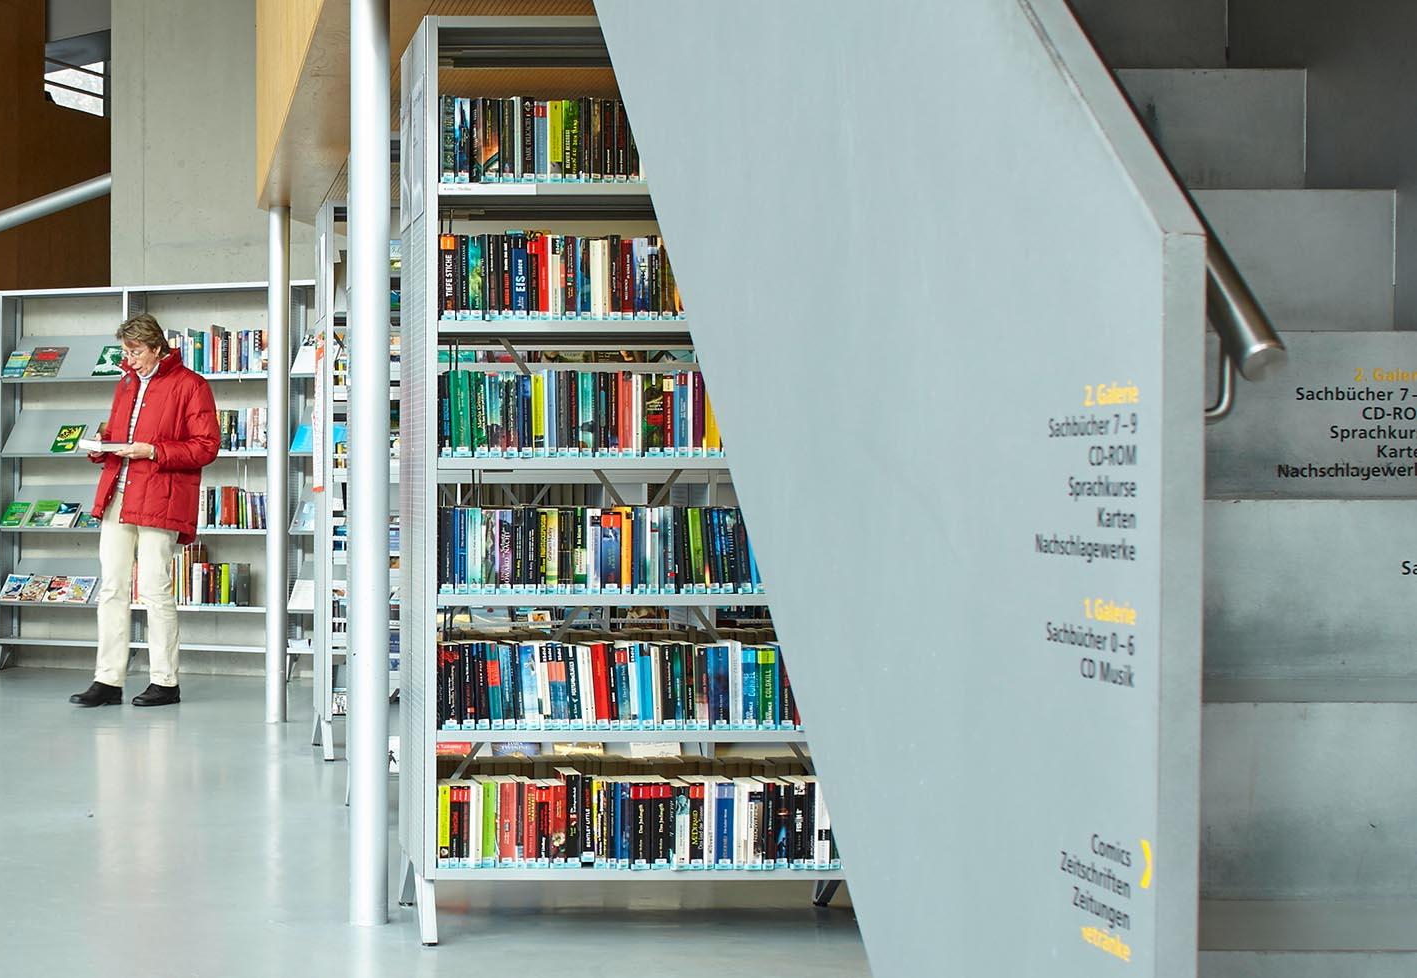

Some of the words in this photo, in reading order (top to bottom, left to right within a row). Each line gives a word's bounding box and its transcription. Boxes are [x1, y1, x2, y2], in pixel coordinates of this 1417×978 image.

[444, 254, 454, 278] STICHE
[444, 278, 454, 297] TIEFE
[1096, 380, 1140, 406] Galerie
[1295, 386, 1394, 401] Sachbücher
[1362, 406, 1417, 420] CD-RO
[1048, 416, 1110, 439] Sachbücher
[1330, 425, 1417, 442] Sprachkur
[1088, 444, 1137, 467] CD-ROM
[1067, 475, 1137, 502] Sprachkurse
[1097, 507, 1136, 530] Karten
[1034, 533, 1136, 563] Nachschlagewerke
[1095, 600, 1137, 626] Galerie
[1046, 621, 1108, 653] Sachbücher
[1080, 657, 1096, 679] CD
[1099, 661, 1135, 688] Musik
[1091, 833, 1131, 867] Comics
[1060, 850, 1131, 899] Zeitschriften
[1072, 885, 1131, 930] Zeitungen
